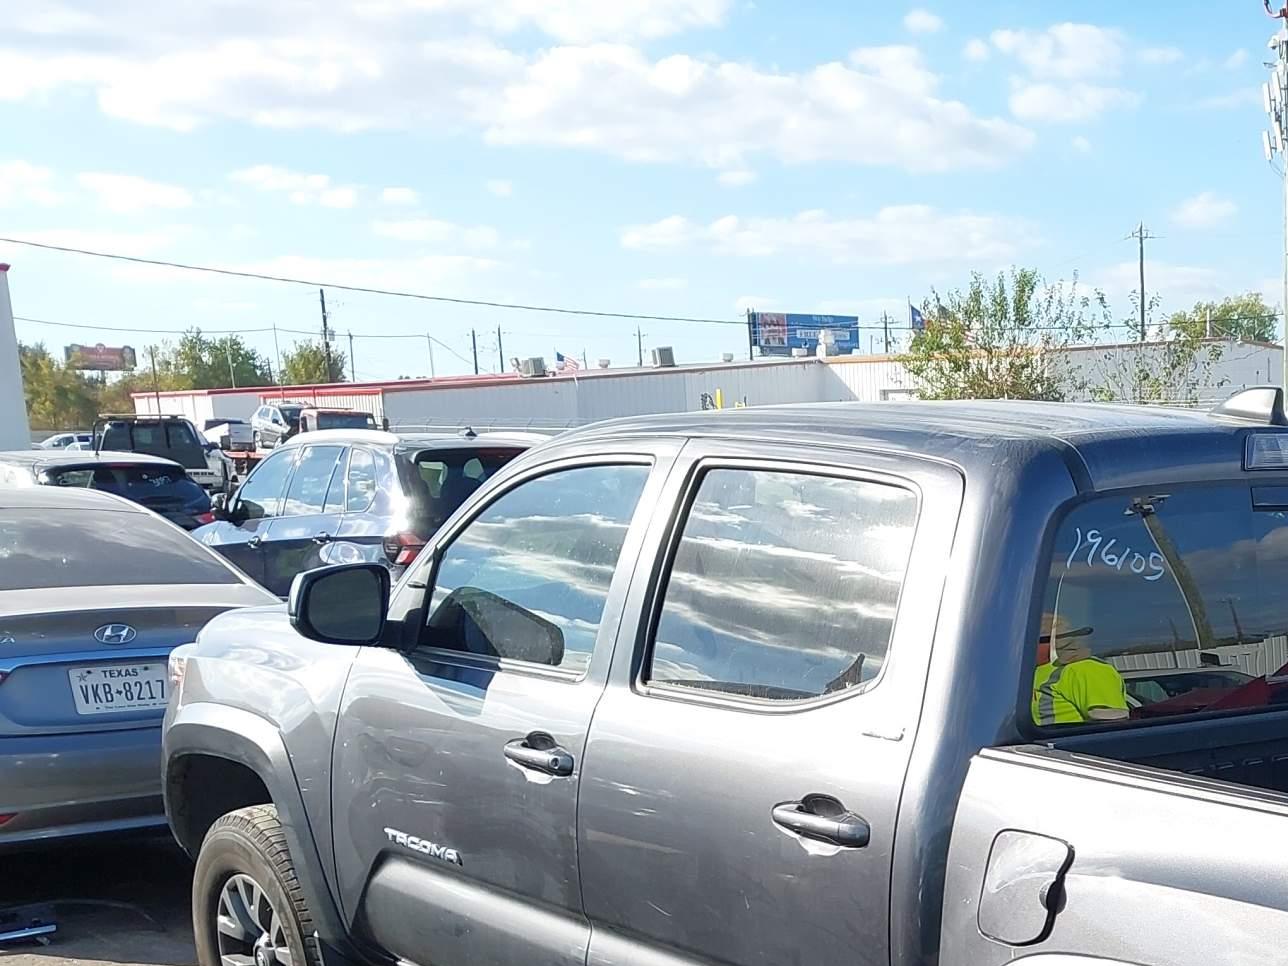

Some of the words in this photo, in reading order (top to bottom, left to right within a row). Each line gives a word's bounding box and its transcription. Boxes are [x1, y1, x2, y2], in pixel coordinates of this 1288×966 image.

[1066, 527, 1165, 580] 196105
[101, 668, 138, 678] TEXAS
[383, 827, 463, 866] TACOMA
